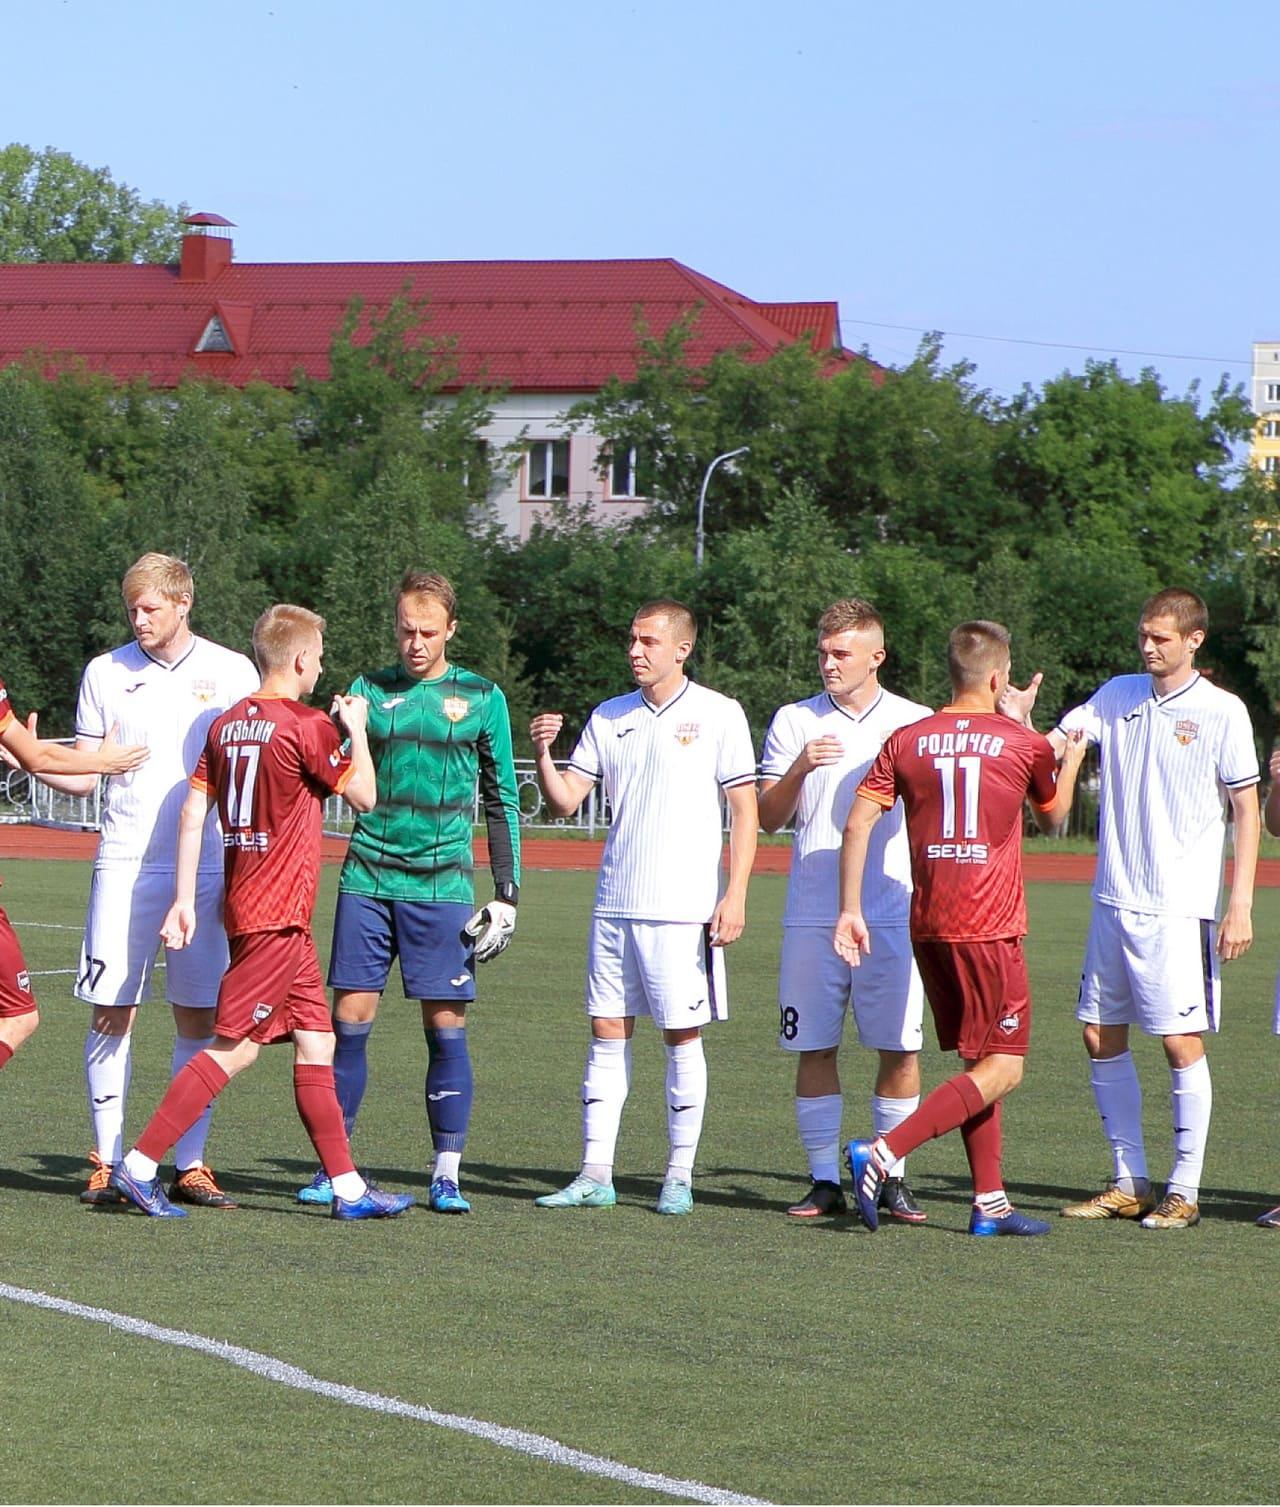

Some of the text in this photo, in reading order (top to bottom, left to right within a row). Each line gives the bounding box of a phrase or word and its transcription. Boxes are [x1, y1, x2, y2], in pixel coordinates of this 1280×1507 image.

[219, 720, 277, 746] КУЗЬКИН
[918, 732, 1005, 757] РОДИЧЕВ
[225, 745, 261, 828] 17
[933, 757, 982, 839] 11
[927, 844, 988, 859] SEUS
